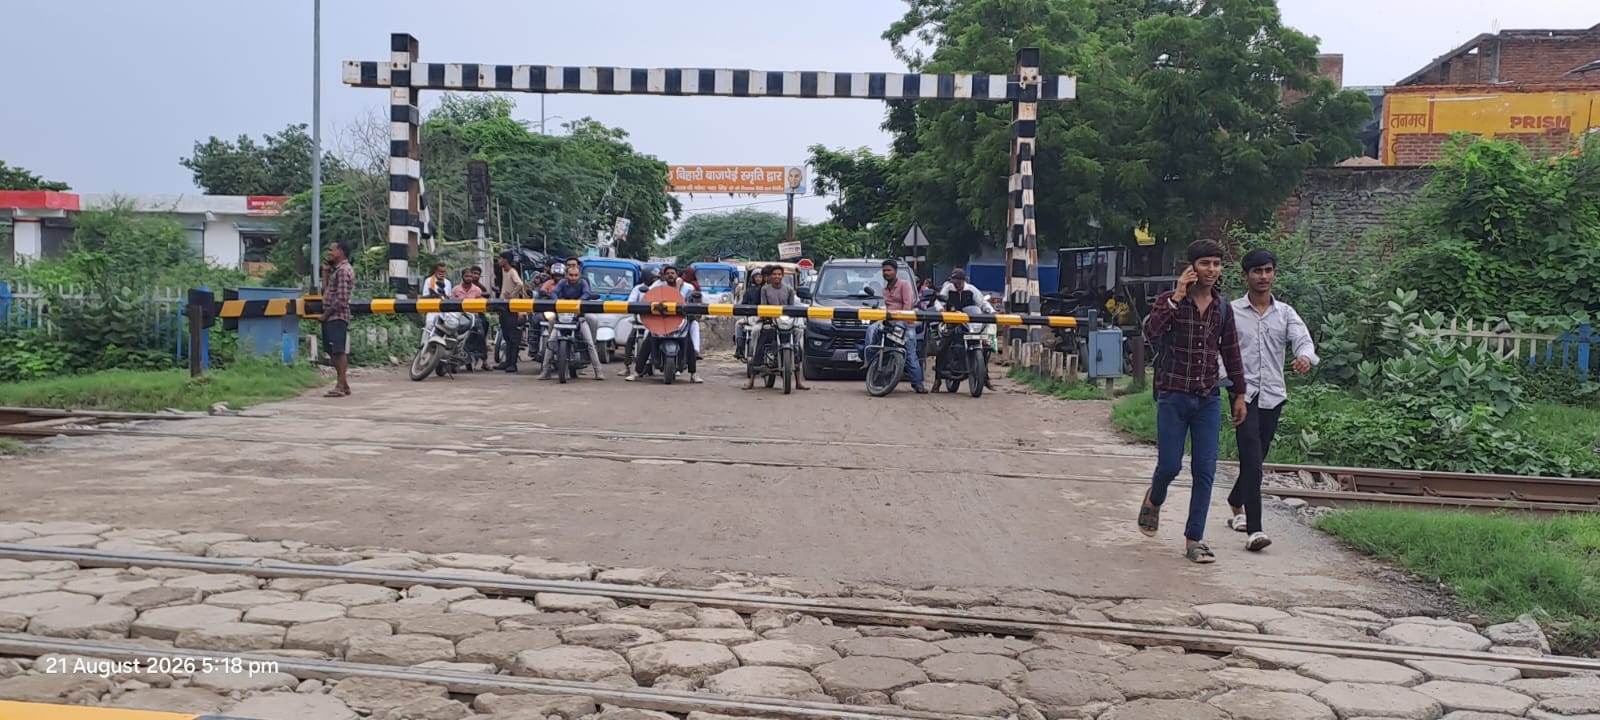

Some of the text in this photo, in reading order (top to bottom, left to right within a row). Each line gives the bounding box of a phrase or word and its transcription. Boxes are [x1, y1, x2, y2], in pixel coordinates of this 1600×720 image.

[1510, 115, 1571, 129] PRISM
[740, 167, 764, 184] स्मृति
[766, 170, 783, 182] द्वार
